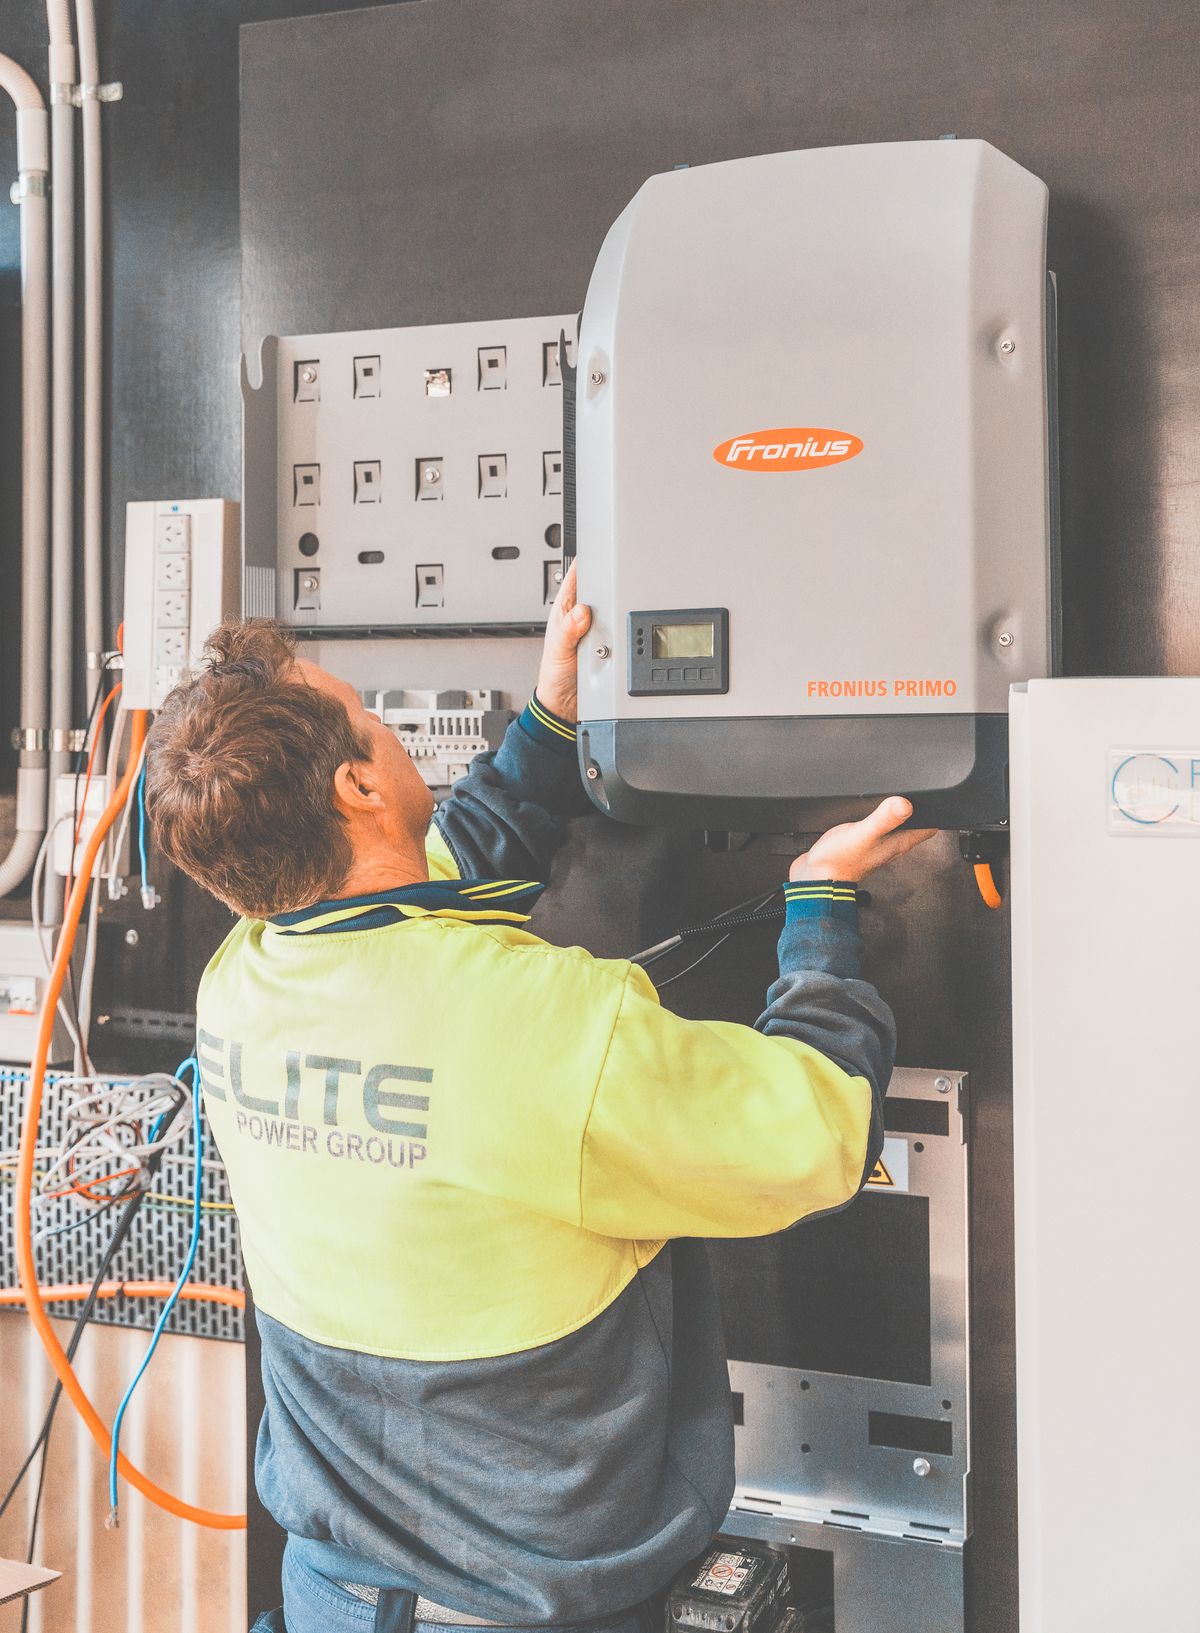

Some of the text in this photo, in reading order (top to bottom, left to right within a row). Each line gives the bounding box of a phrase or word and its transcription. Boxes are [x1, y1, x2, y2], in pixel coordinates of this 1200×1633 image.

[725, 437, 852, 462] Fronius
[807, 680, 957, 697] FRONIUS PRIMO
[198, 1028, 434, 1139] ELITE
[236, 1111, 428, 1169] POWER GROUP
